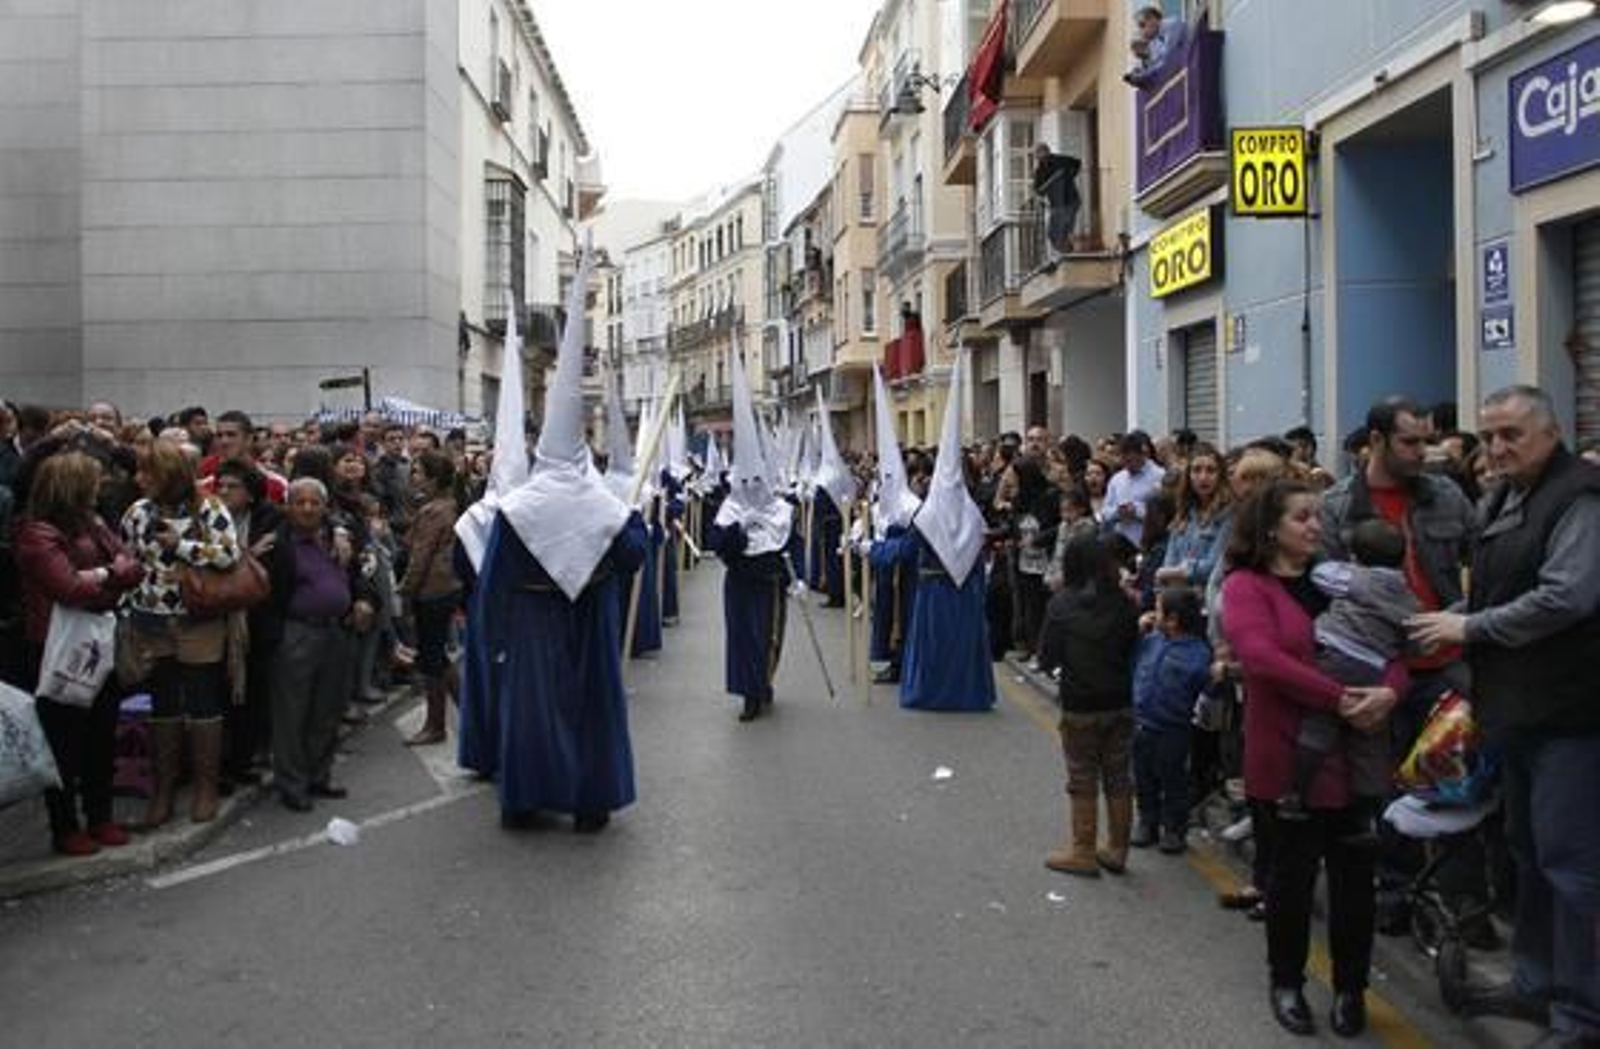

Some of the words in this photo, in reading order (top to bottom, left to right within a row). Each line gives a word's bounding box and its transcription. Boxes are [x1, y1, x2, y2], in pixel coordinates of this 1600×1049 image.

[1238, 135, 1298, 154] COMPRO
[1239, 160, 1300, 206] ORO
[1152, 238, 1206, 289] ORO
